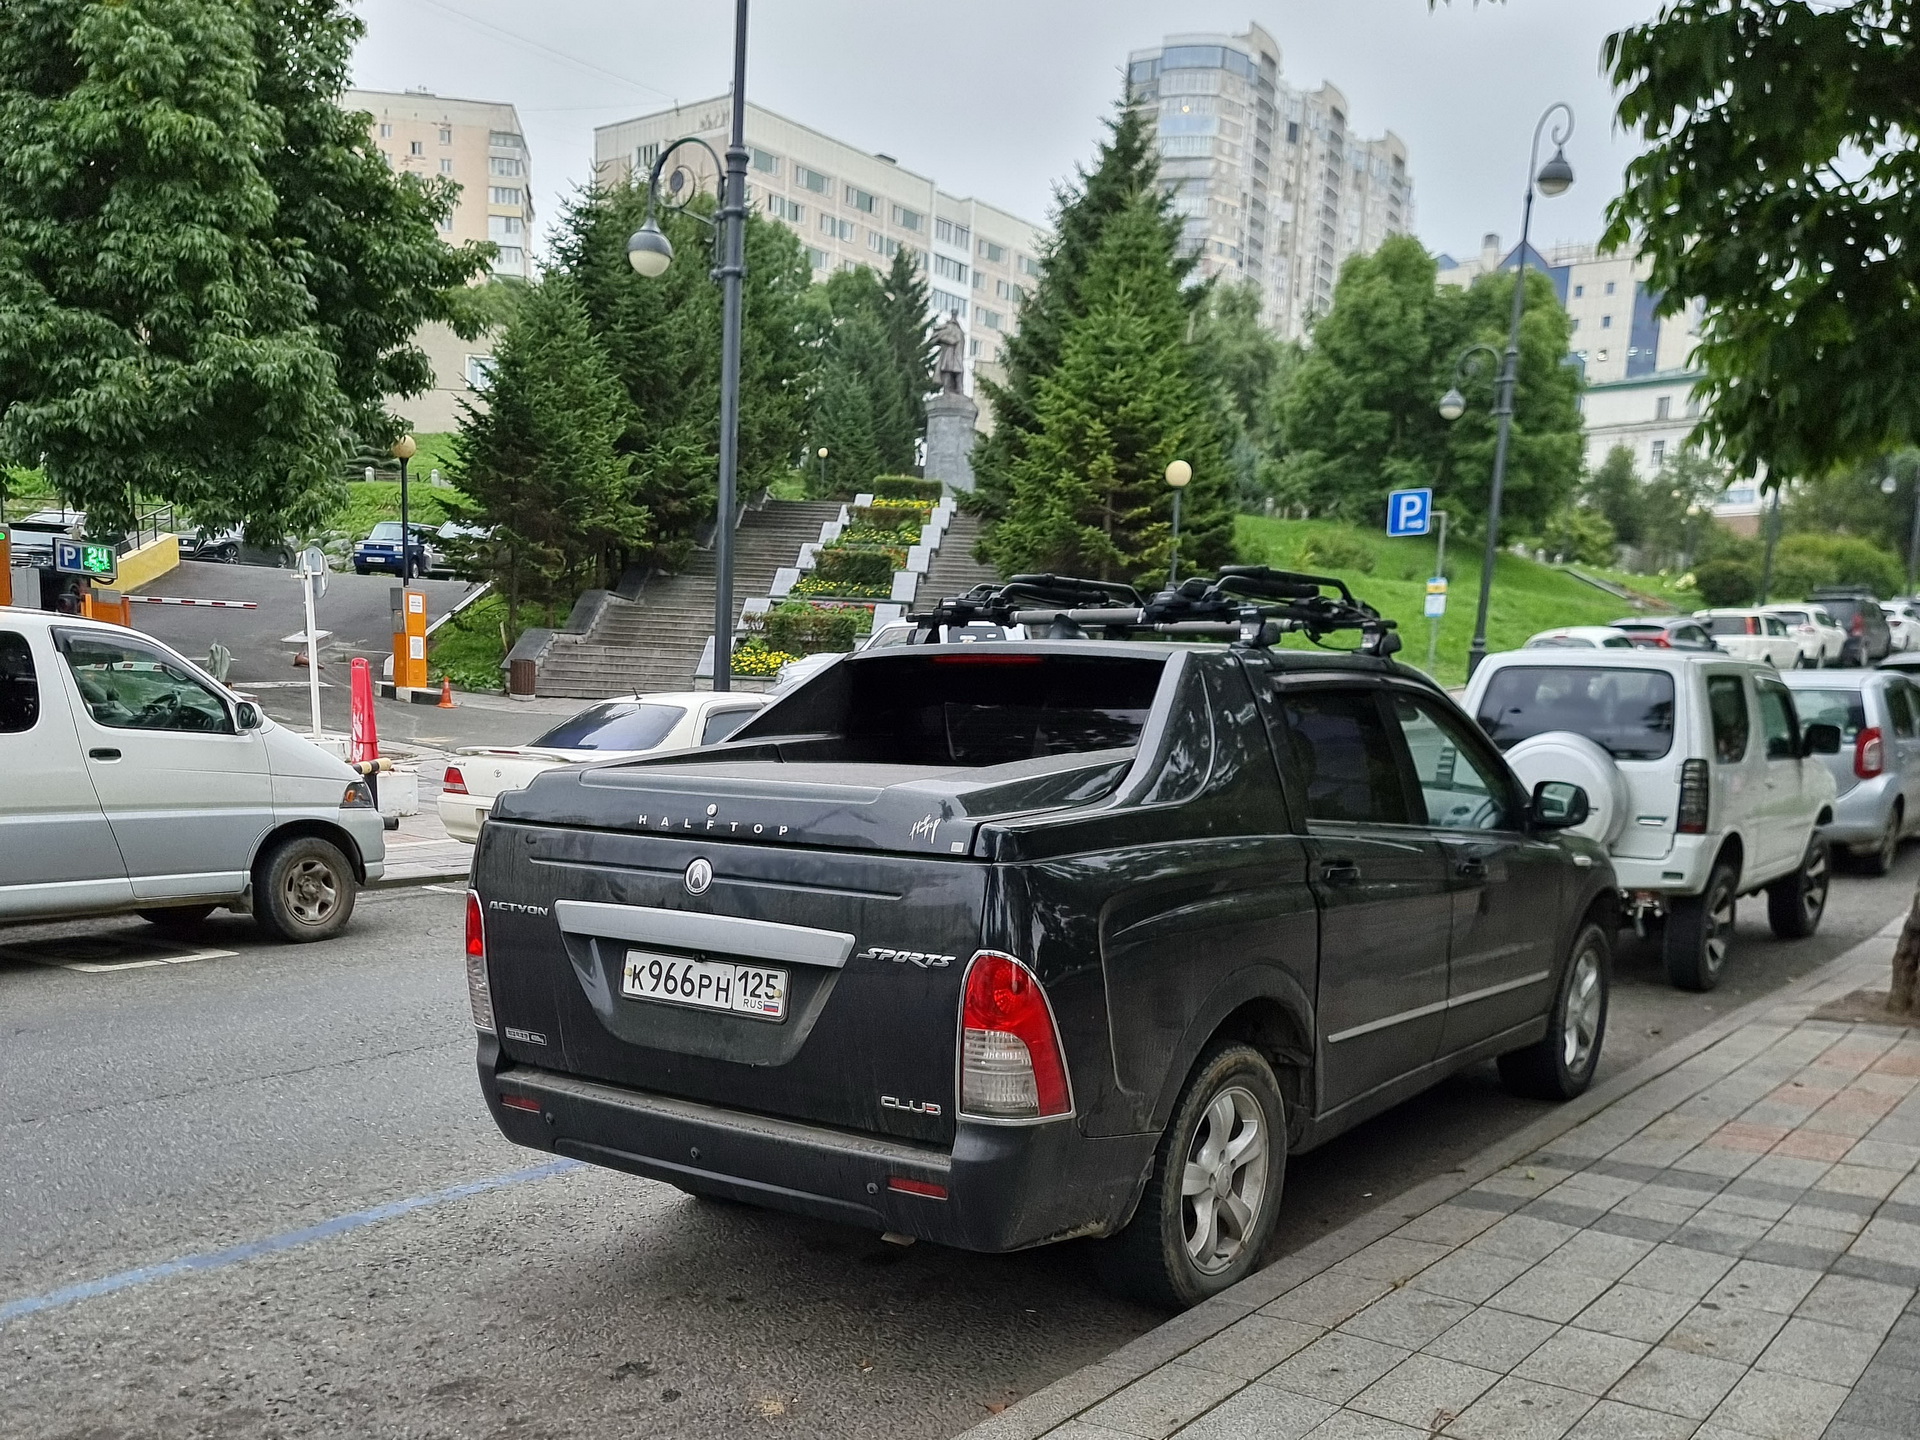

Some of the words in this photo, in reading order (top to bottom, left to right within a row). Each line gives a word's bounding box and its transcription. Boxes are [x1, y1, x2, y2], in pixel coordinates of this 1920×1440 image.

[1399, 495, 1423, 530] P
[63, 546, 77, 566] P
[87, 546, 109, 565] 24
[638, 814, 789, 837] HALFTOP
[488, 900, 549, 916] ACTYON
[856, 947, 957, 969] SPORTS
[737, 970, 779, 1000] 125
[743, 998, 763, 1010] RUS
[880, 1095, 942, 1116] CLUB
